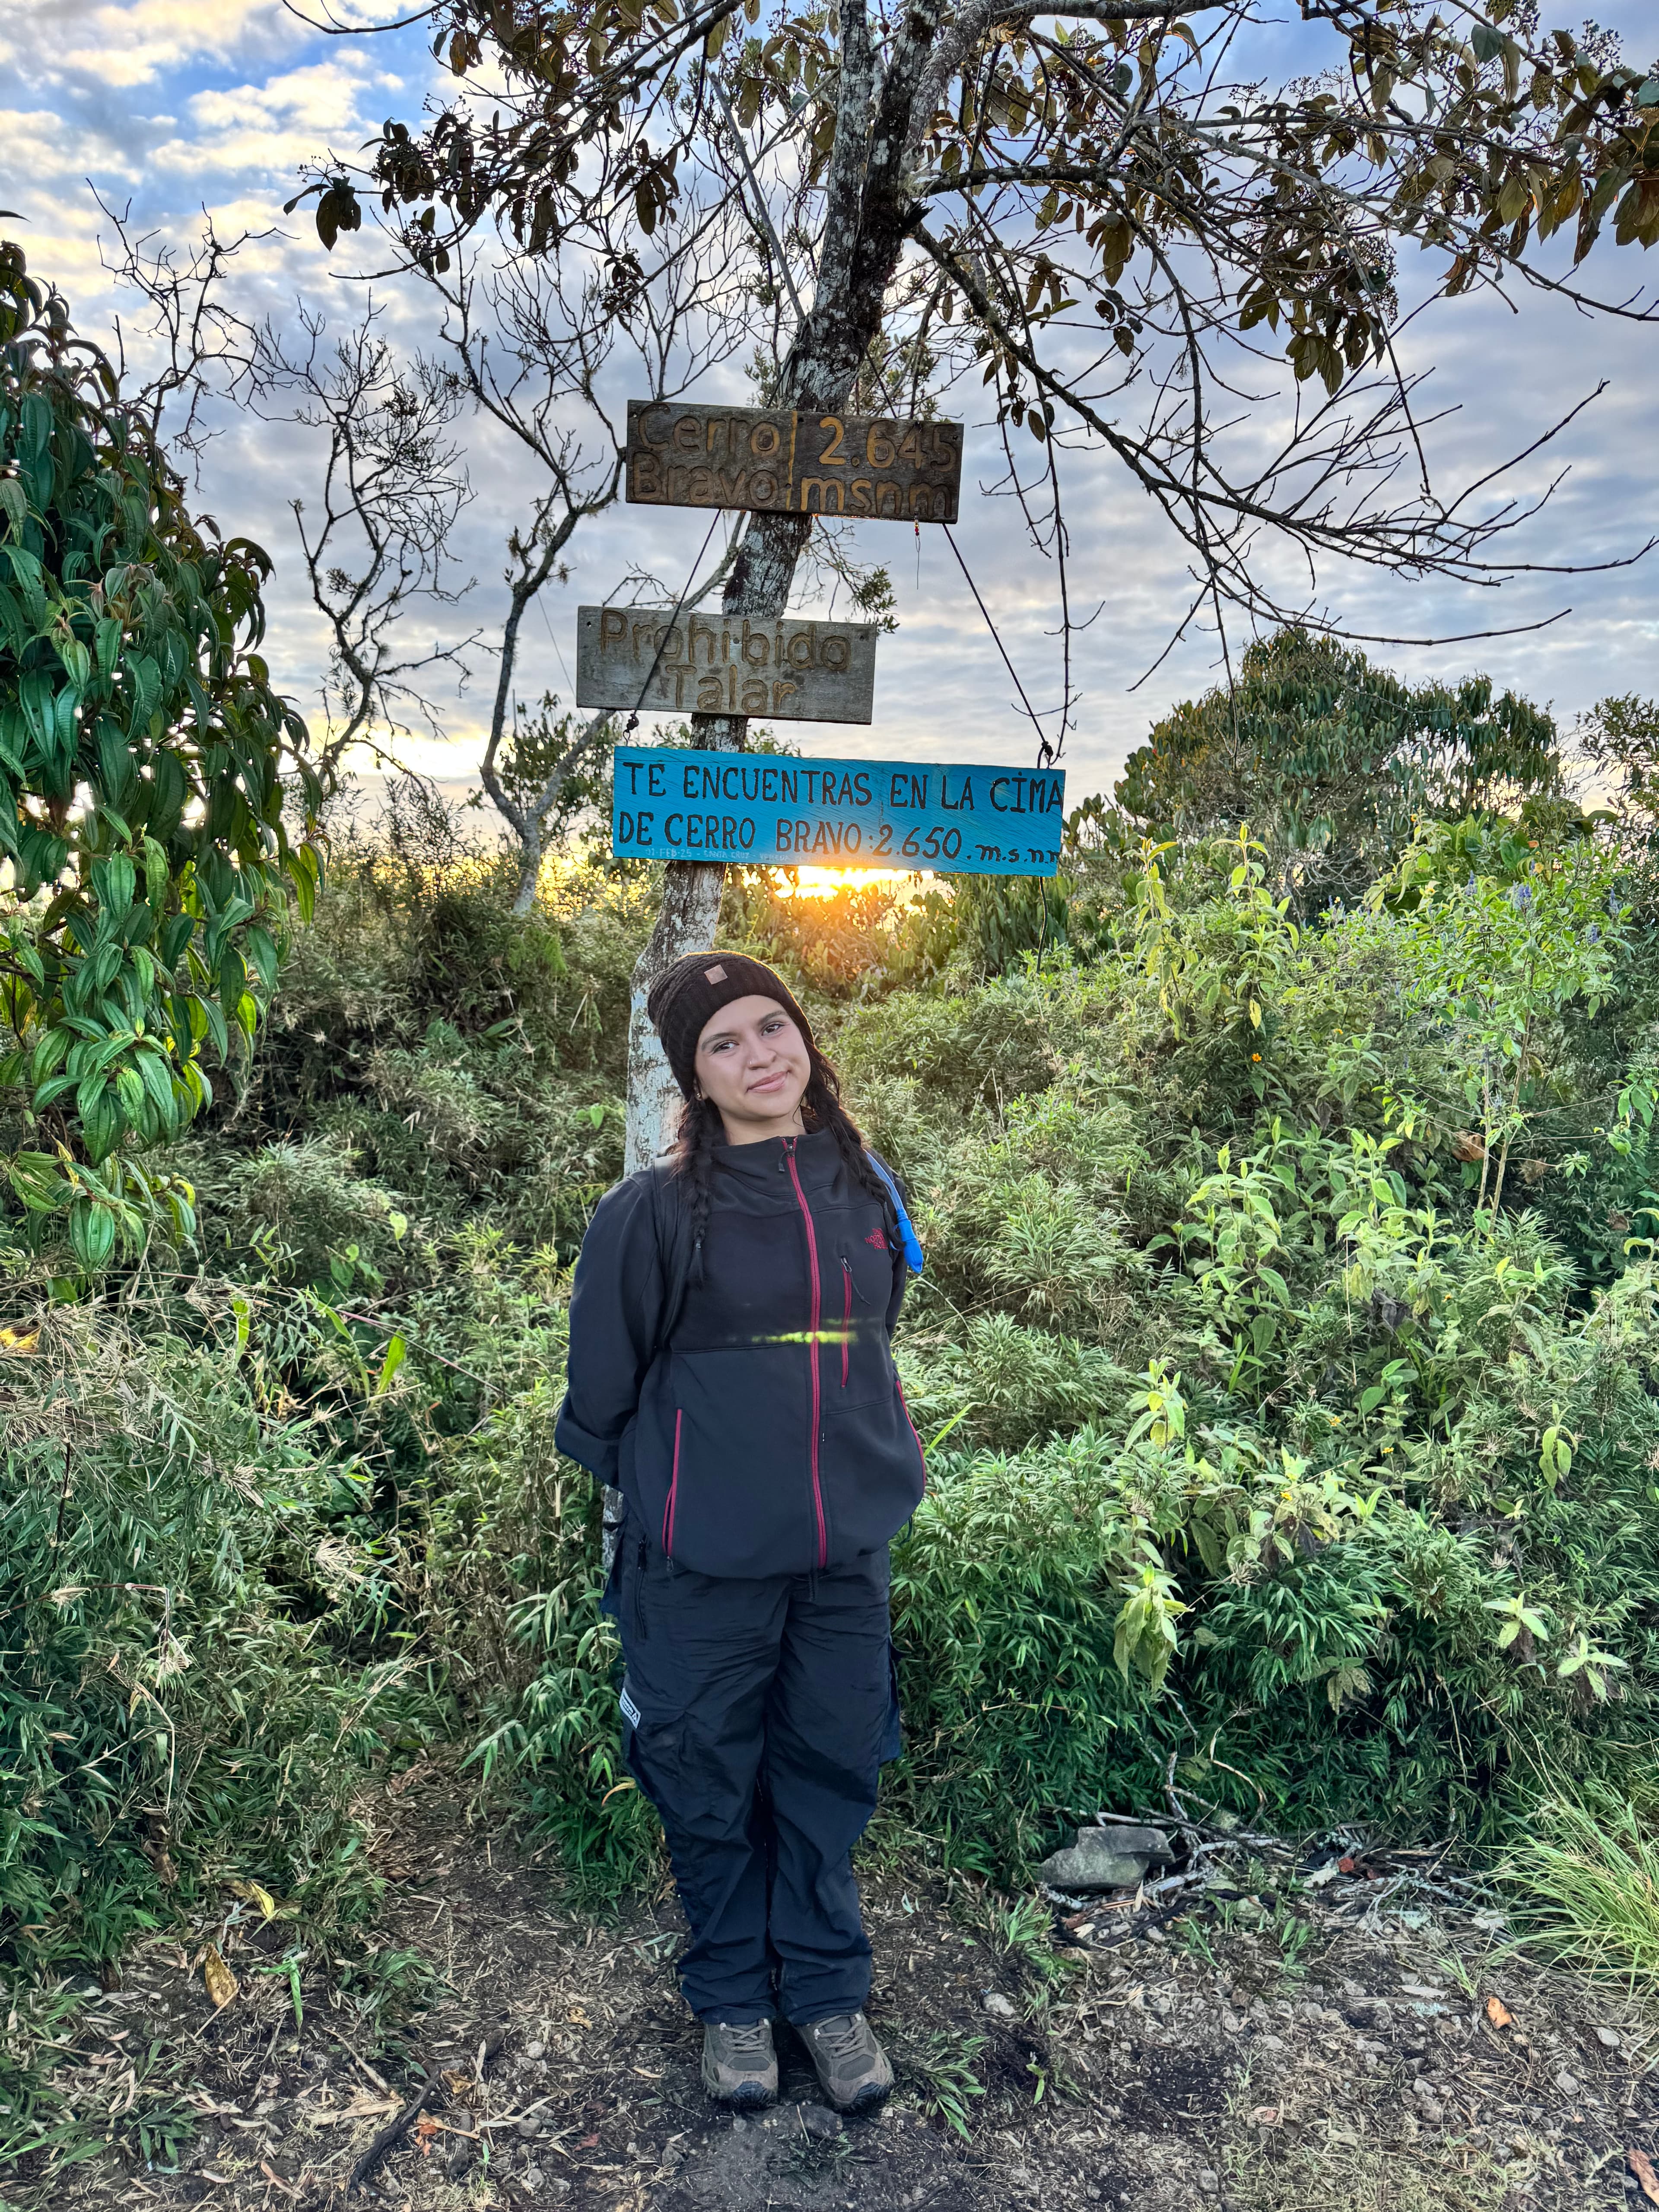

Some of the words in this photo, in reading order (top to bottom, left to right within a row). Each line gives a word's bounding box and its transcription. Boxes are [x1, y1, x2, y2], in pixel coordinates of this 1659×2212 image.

[638, 402, 780, 457] Cerro
[818, 416, 958, 473] 2.645
[632, 451, 778, 507] Bravo
[800, 476, 950, 518] msnm
[600, 610, 852, 671] Prohibido
[665, 664, 796, 714] Talar
[623, 762, 666, 797] TE
[683, 766, 872, 807] ENCUENTRAS
[890, 773, 928, 810] EN
[941, 775, 975, 810] LA
[619, 811, 654, 846] DE
[664, 813, 756, 850] CERRO
